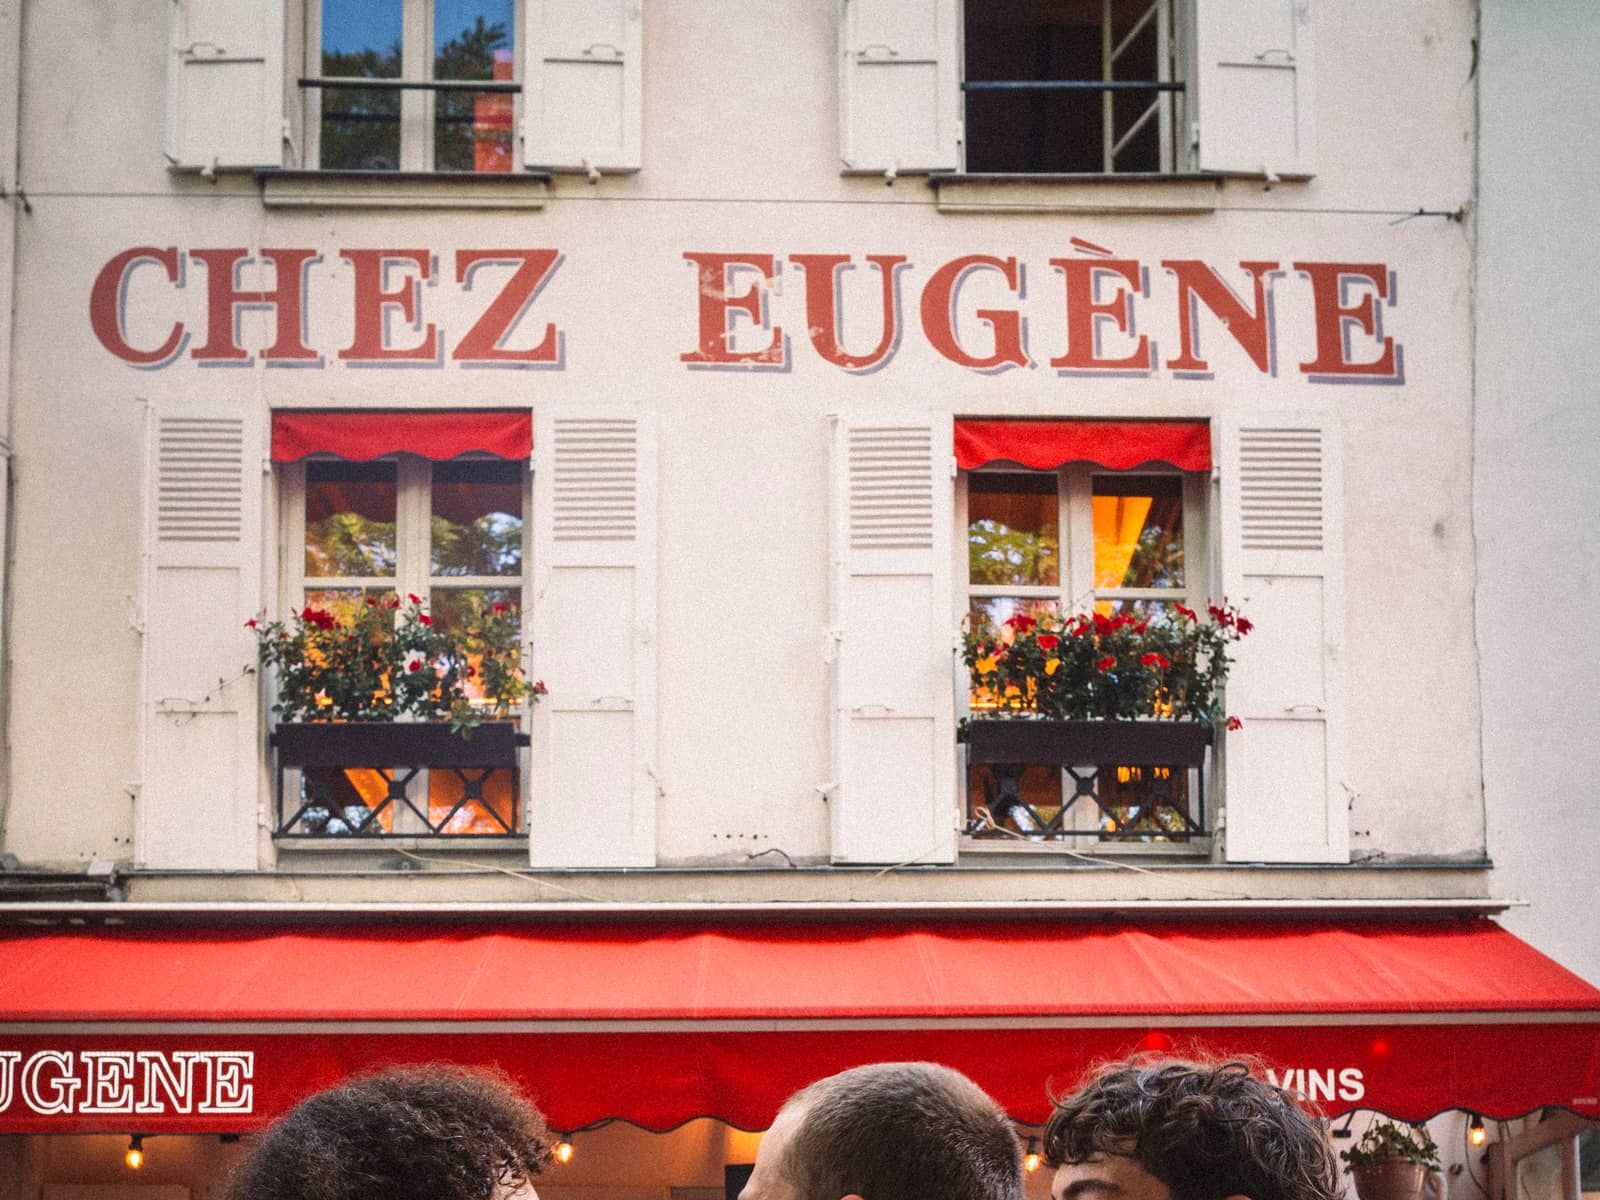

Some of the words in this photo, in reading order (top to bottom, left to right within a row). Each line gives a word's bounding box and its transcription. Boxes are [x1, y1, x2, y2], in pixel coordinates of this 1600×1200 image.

[90, 246, 566, 370] CHEZ
[680, 236, 1405, 384] EUGÈNE
[1266, 1068, 1365, 1102] VINS
